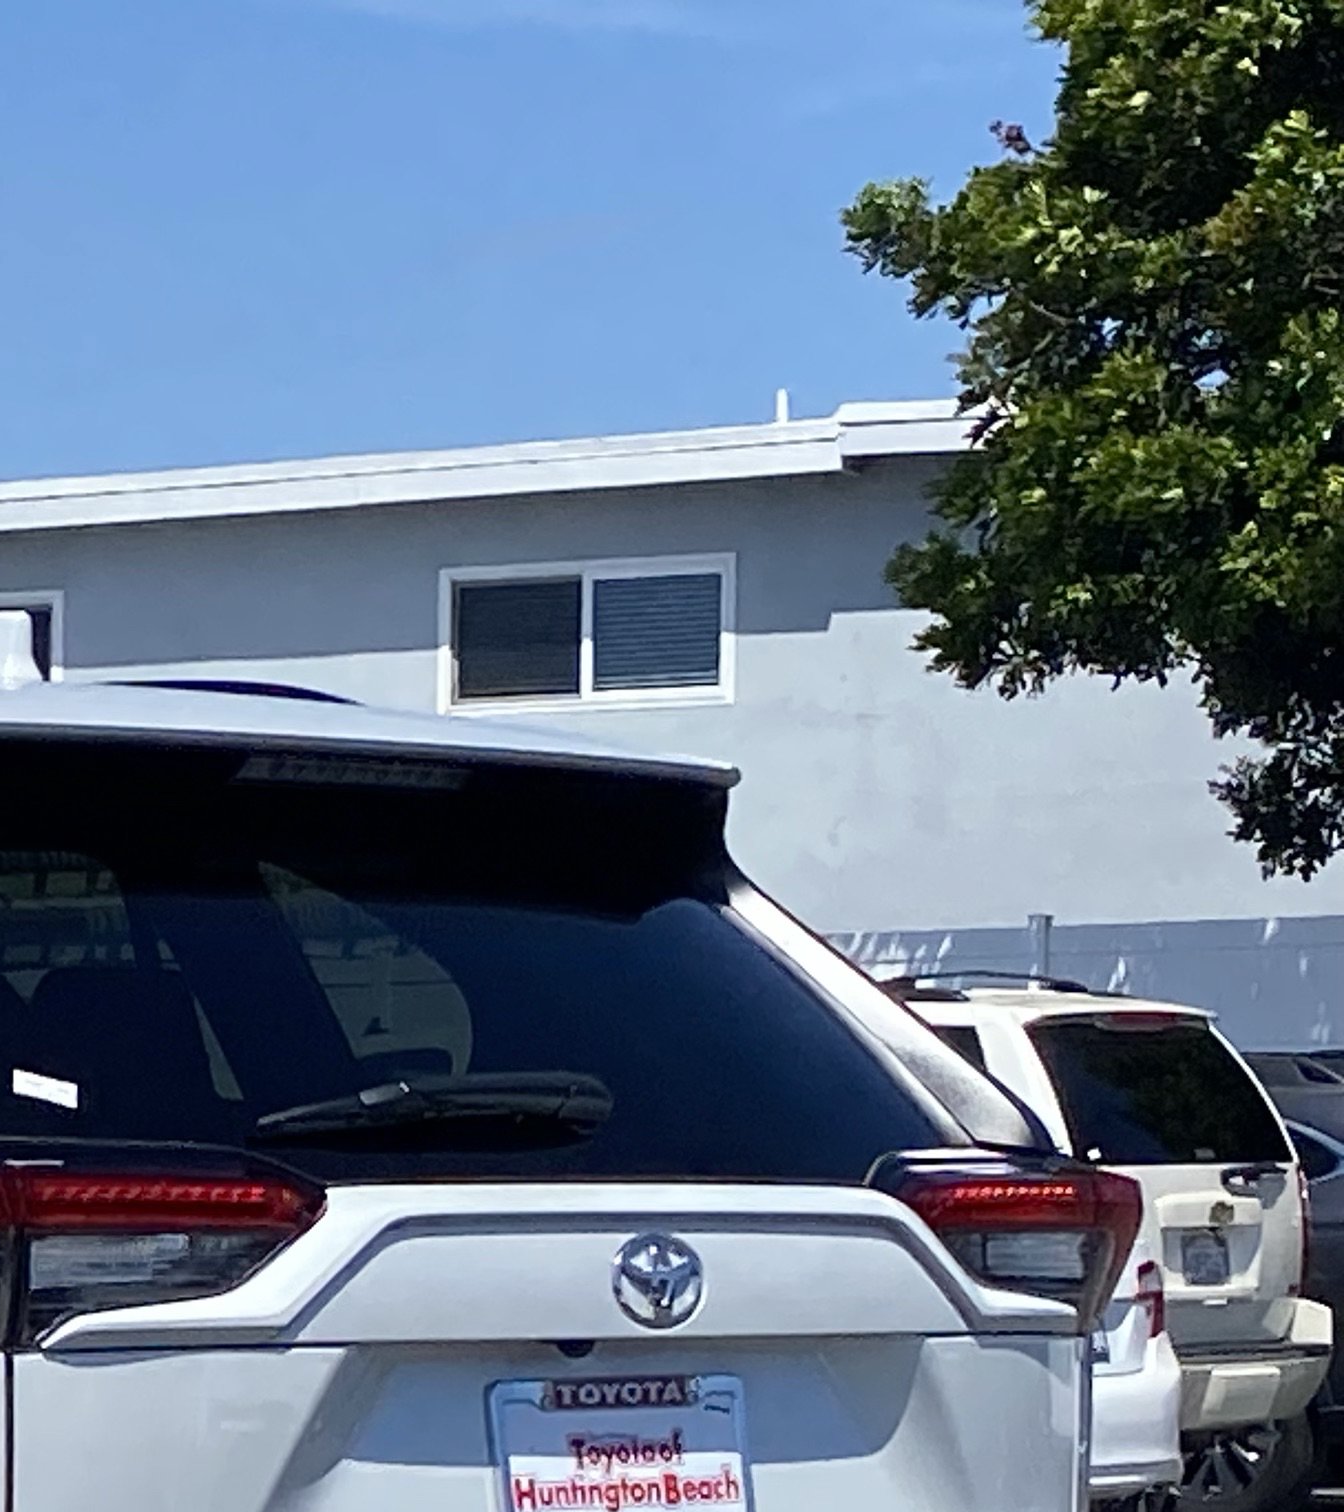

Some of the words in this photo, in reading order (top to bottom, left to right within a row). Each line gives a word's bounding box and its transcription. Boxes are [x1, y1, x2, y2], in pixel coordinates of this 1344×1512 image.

[556, 1380, 683, 1404] TOYOTA
[514, 1476, 661, 1512] Huntington
[663, 1473, 740, 1505] Beach
